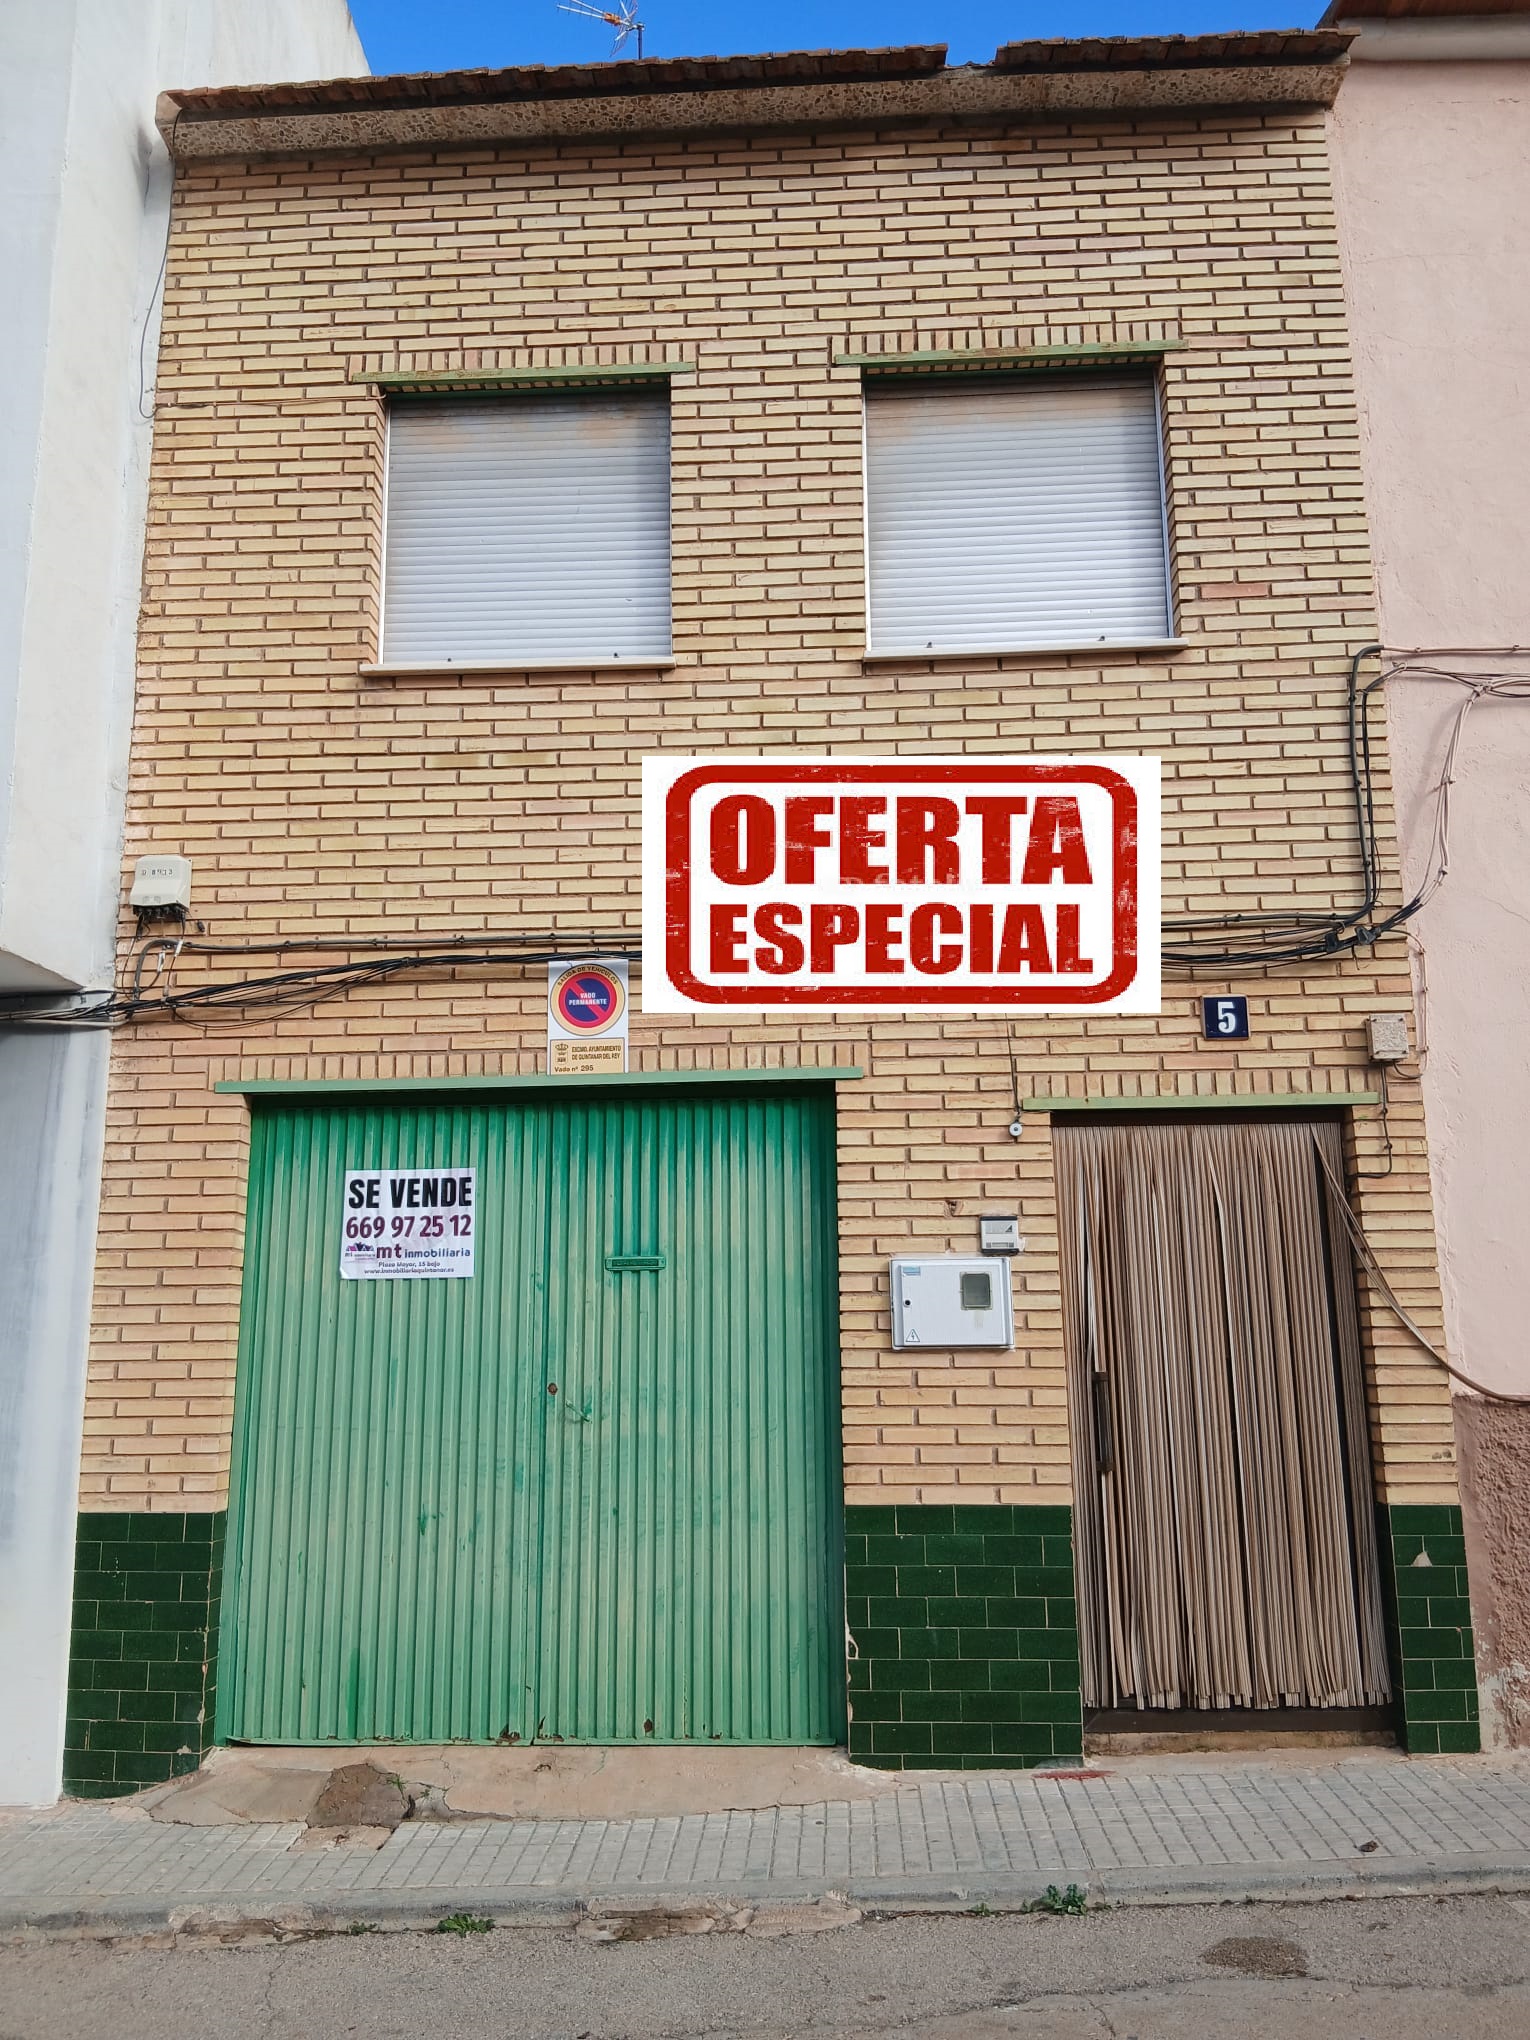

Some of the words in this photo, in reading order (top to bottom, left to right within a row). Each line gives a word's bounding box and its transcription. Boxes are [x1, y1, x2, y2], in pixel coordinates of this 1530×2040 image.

[557, 969, 577, 986] SALIDA
[568, 998, 607, 1006] PERMANENTE
[1217, 1001, 1237, 1034] 5
[580, 1064, 594, 1072] 295
[348, 1178, 380, 1209] SE
[390, 1177, 472, 1208] VENDE
[346, 1216, 385, 1239] 669
[391, 1216, 415, 1238] 97
[419, 1215, 444, 1238] 25
[449, 1214, 472, 1237] 12
[376, 1243, 402, 1259] mt
[404, 1247, 471, 1259] inmobiliaria
[426, 1260, 441, 1268] bajo
